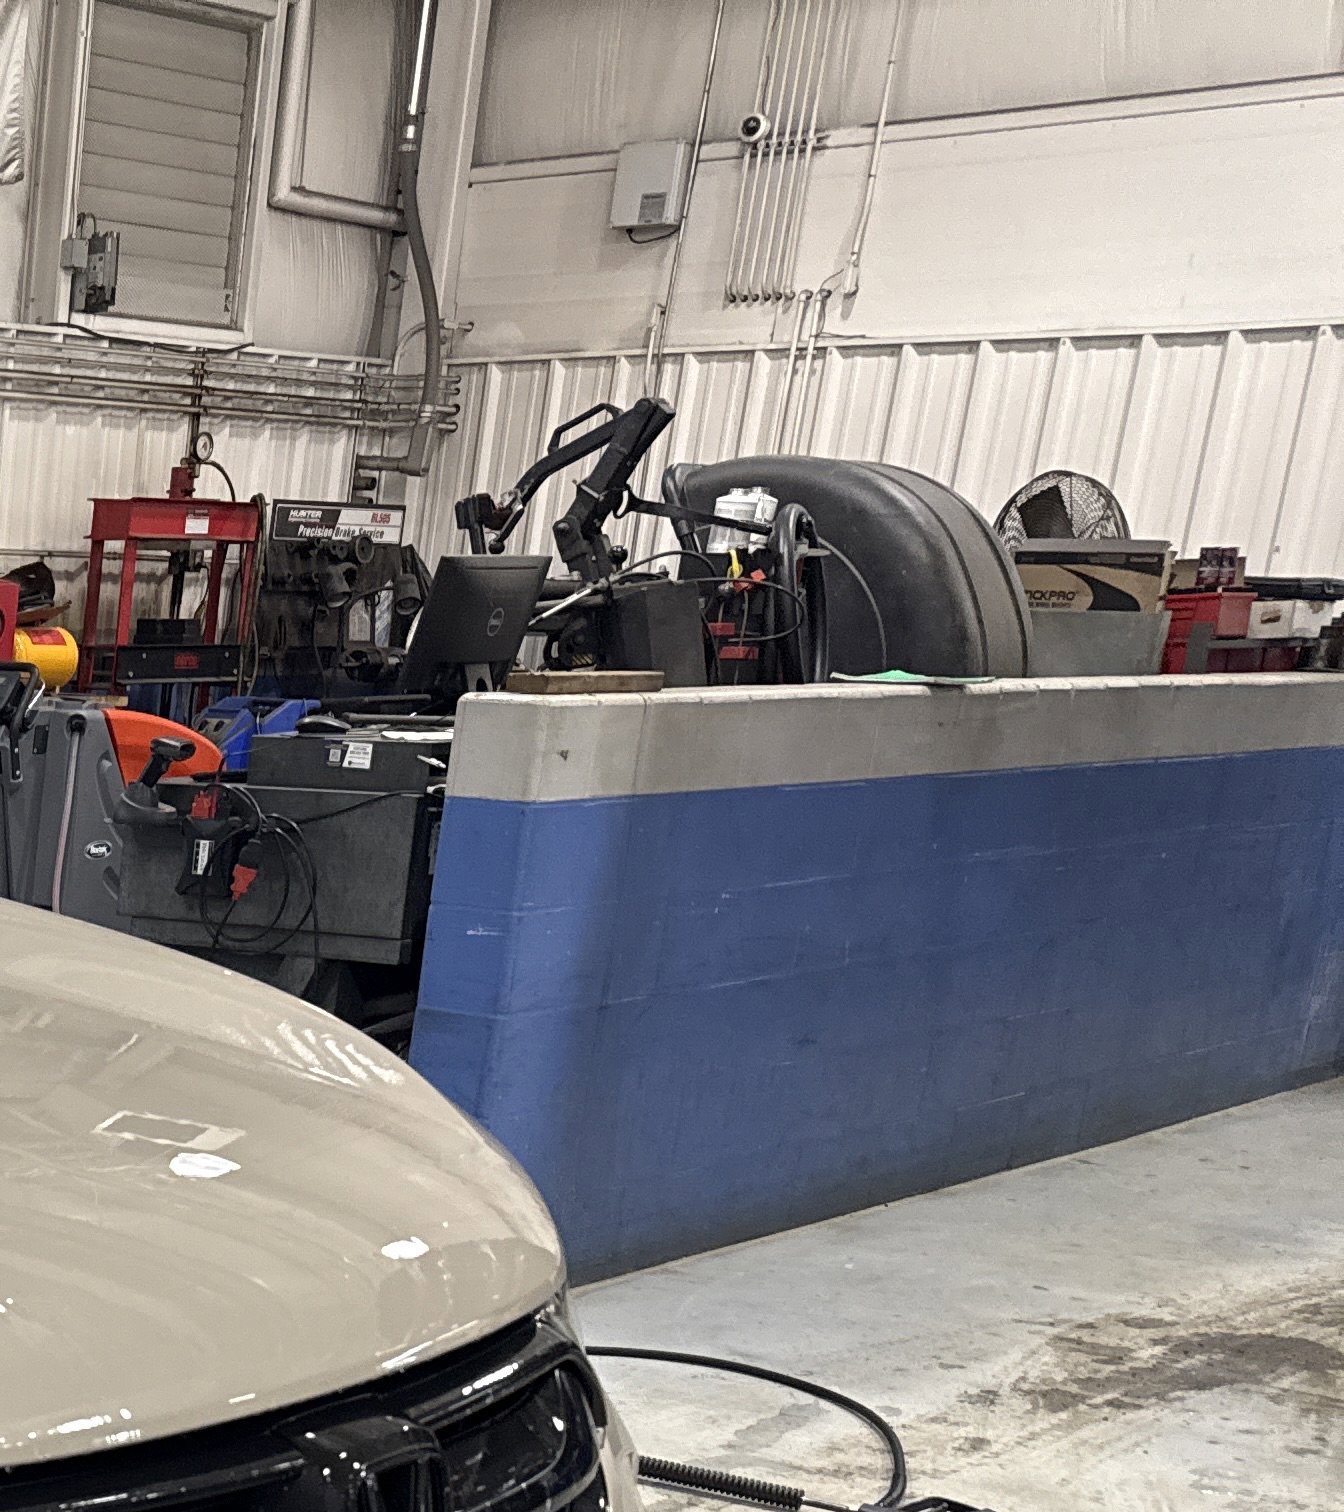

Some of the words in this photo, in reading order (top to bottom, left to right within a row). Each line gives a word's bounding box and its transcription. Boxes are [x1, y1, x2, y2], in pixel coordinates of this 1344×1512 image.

[289, 509, 323, 519] HUNTER
[297, 524, 334, 538] Precision
[334, 526, 356, 538] Brake
[358, 527, 385, 539] Service
